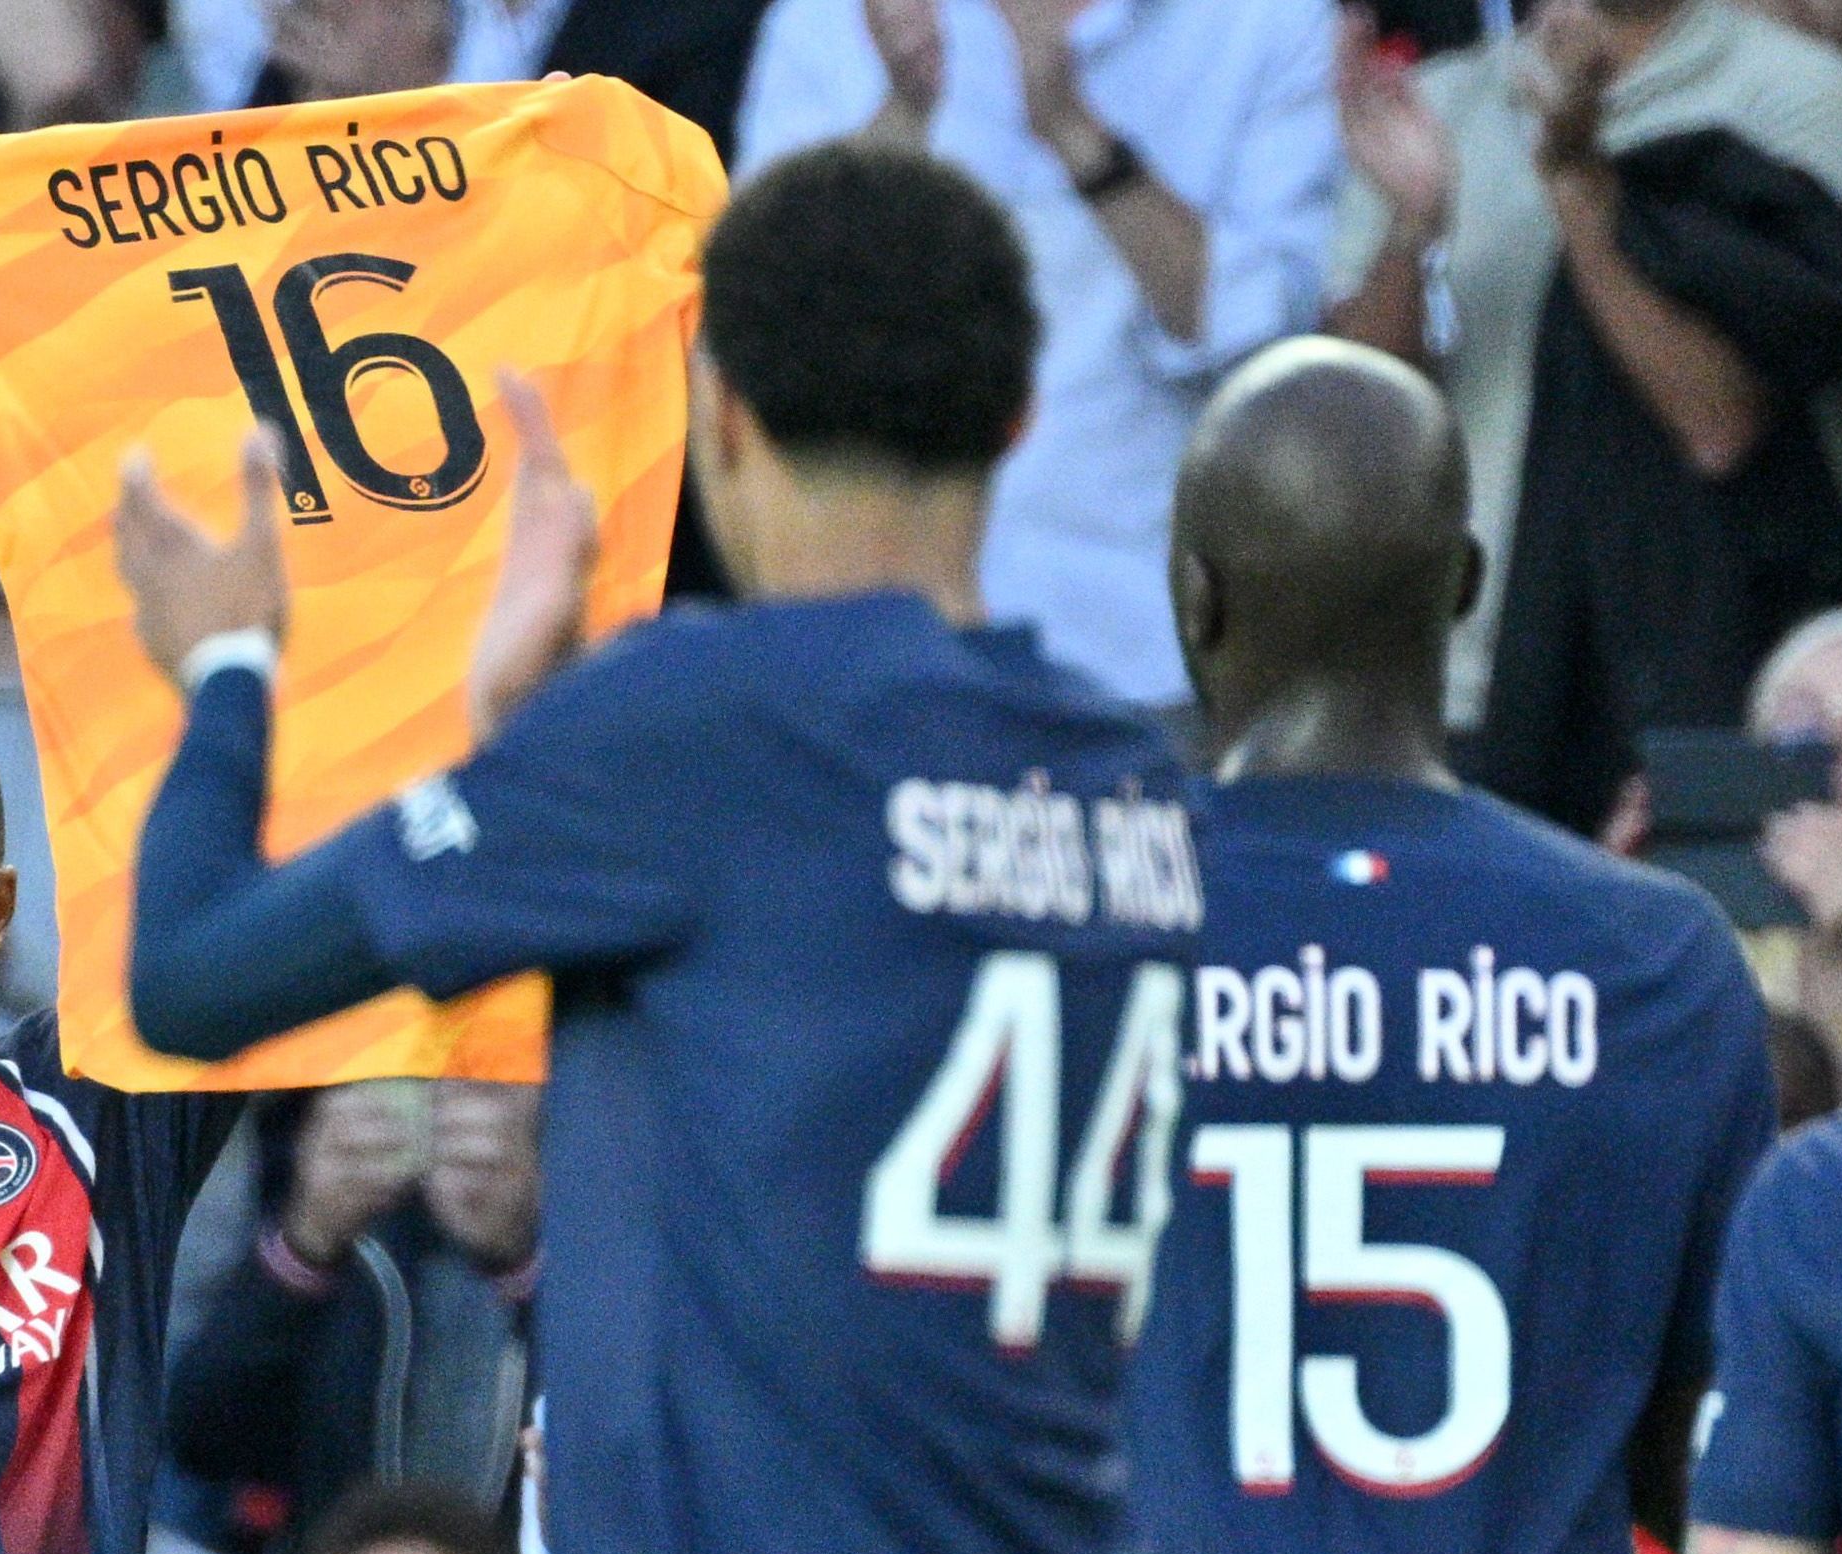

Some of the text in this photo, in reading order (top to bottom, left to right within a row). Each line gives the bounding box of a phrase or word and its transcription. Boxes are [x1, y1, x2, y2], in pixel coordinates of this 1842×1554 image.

[167, 252, 491, 526] 16
[860, 948, 1185, 1360] 44
[1187, 1123, 1512, 1498] 15
